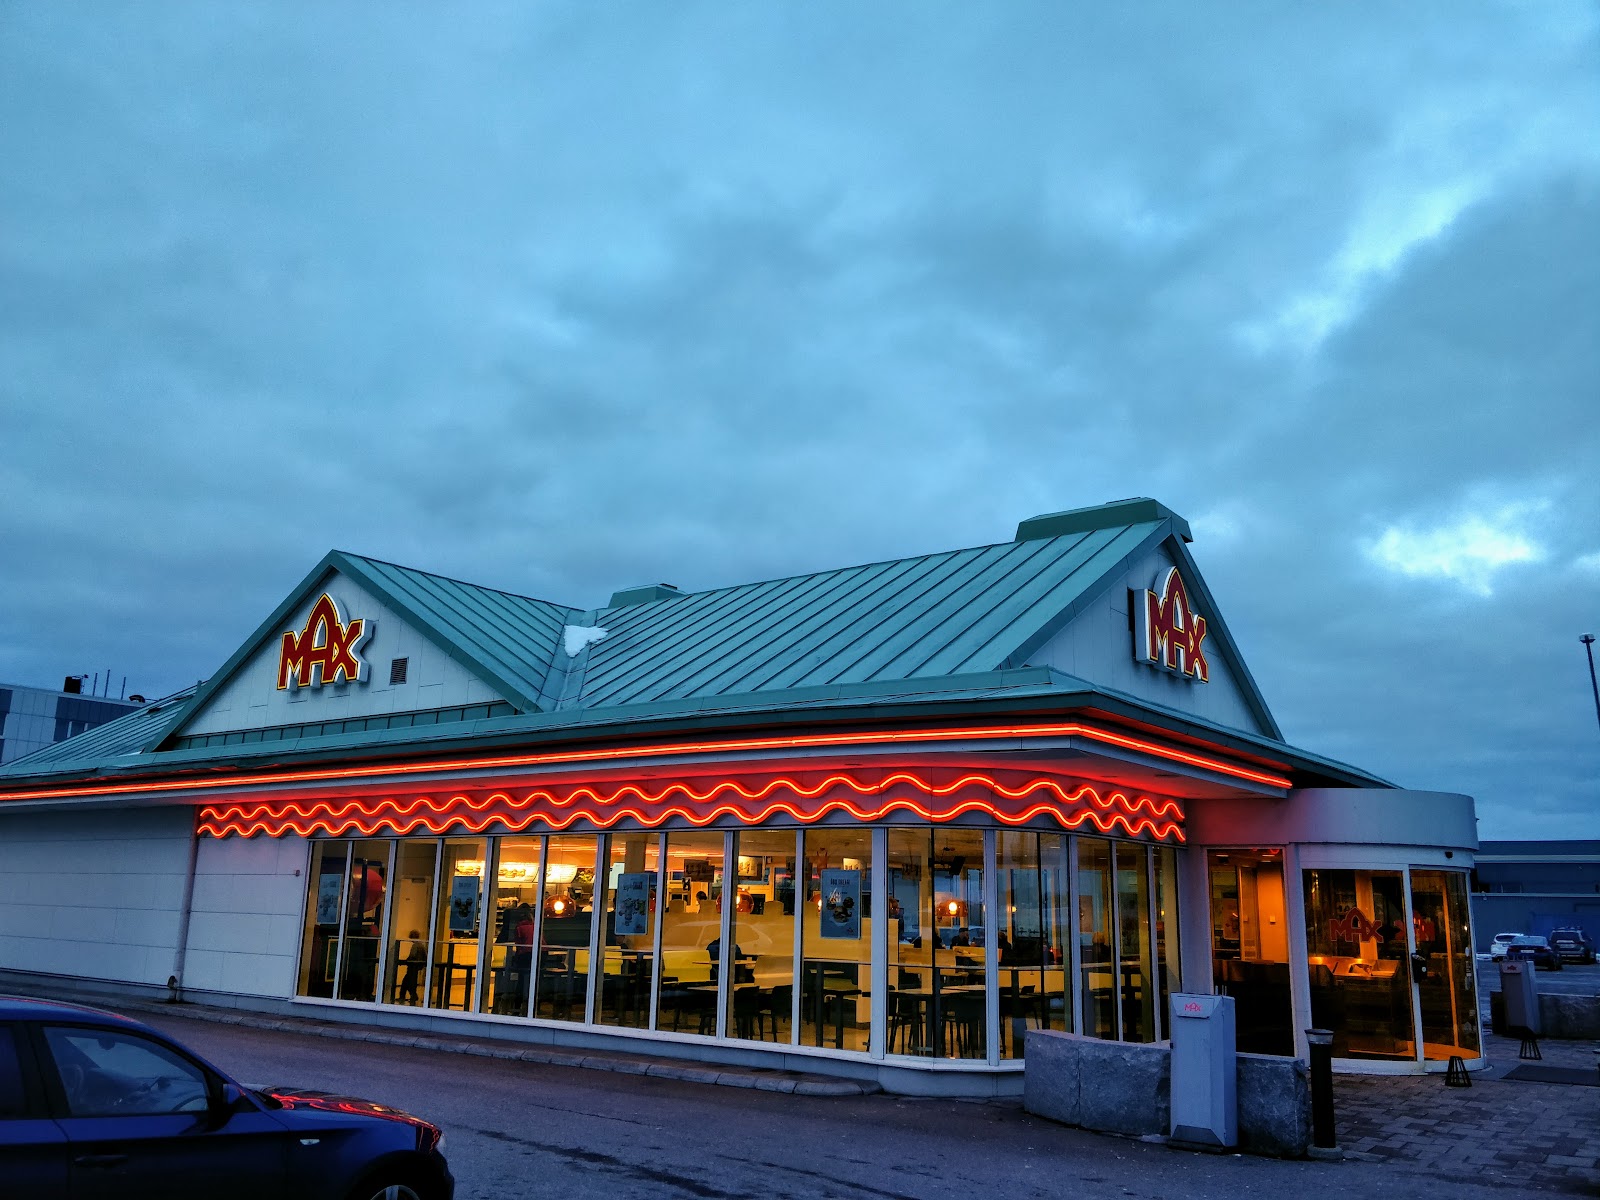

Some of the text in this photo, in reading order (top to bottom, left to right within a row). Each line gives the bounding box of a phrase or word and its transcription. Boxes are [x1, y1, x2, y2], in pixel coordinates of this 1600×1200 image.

[277, 593, 364, 690] MAX
[1146, 567, 1209, 683] MAX
[1329, 907, 1384, 943] MAX
